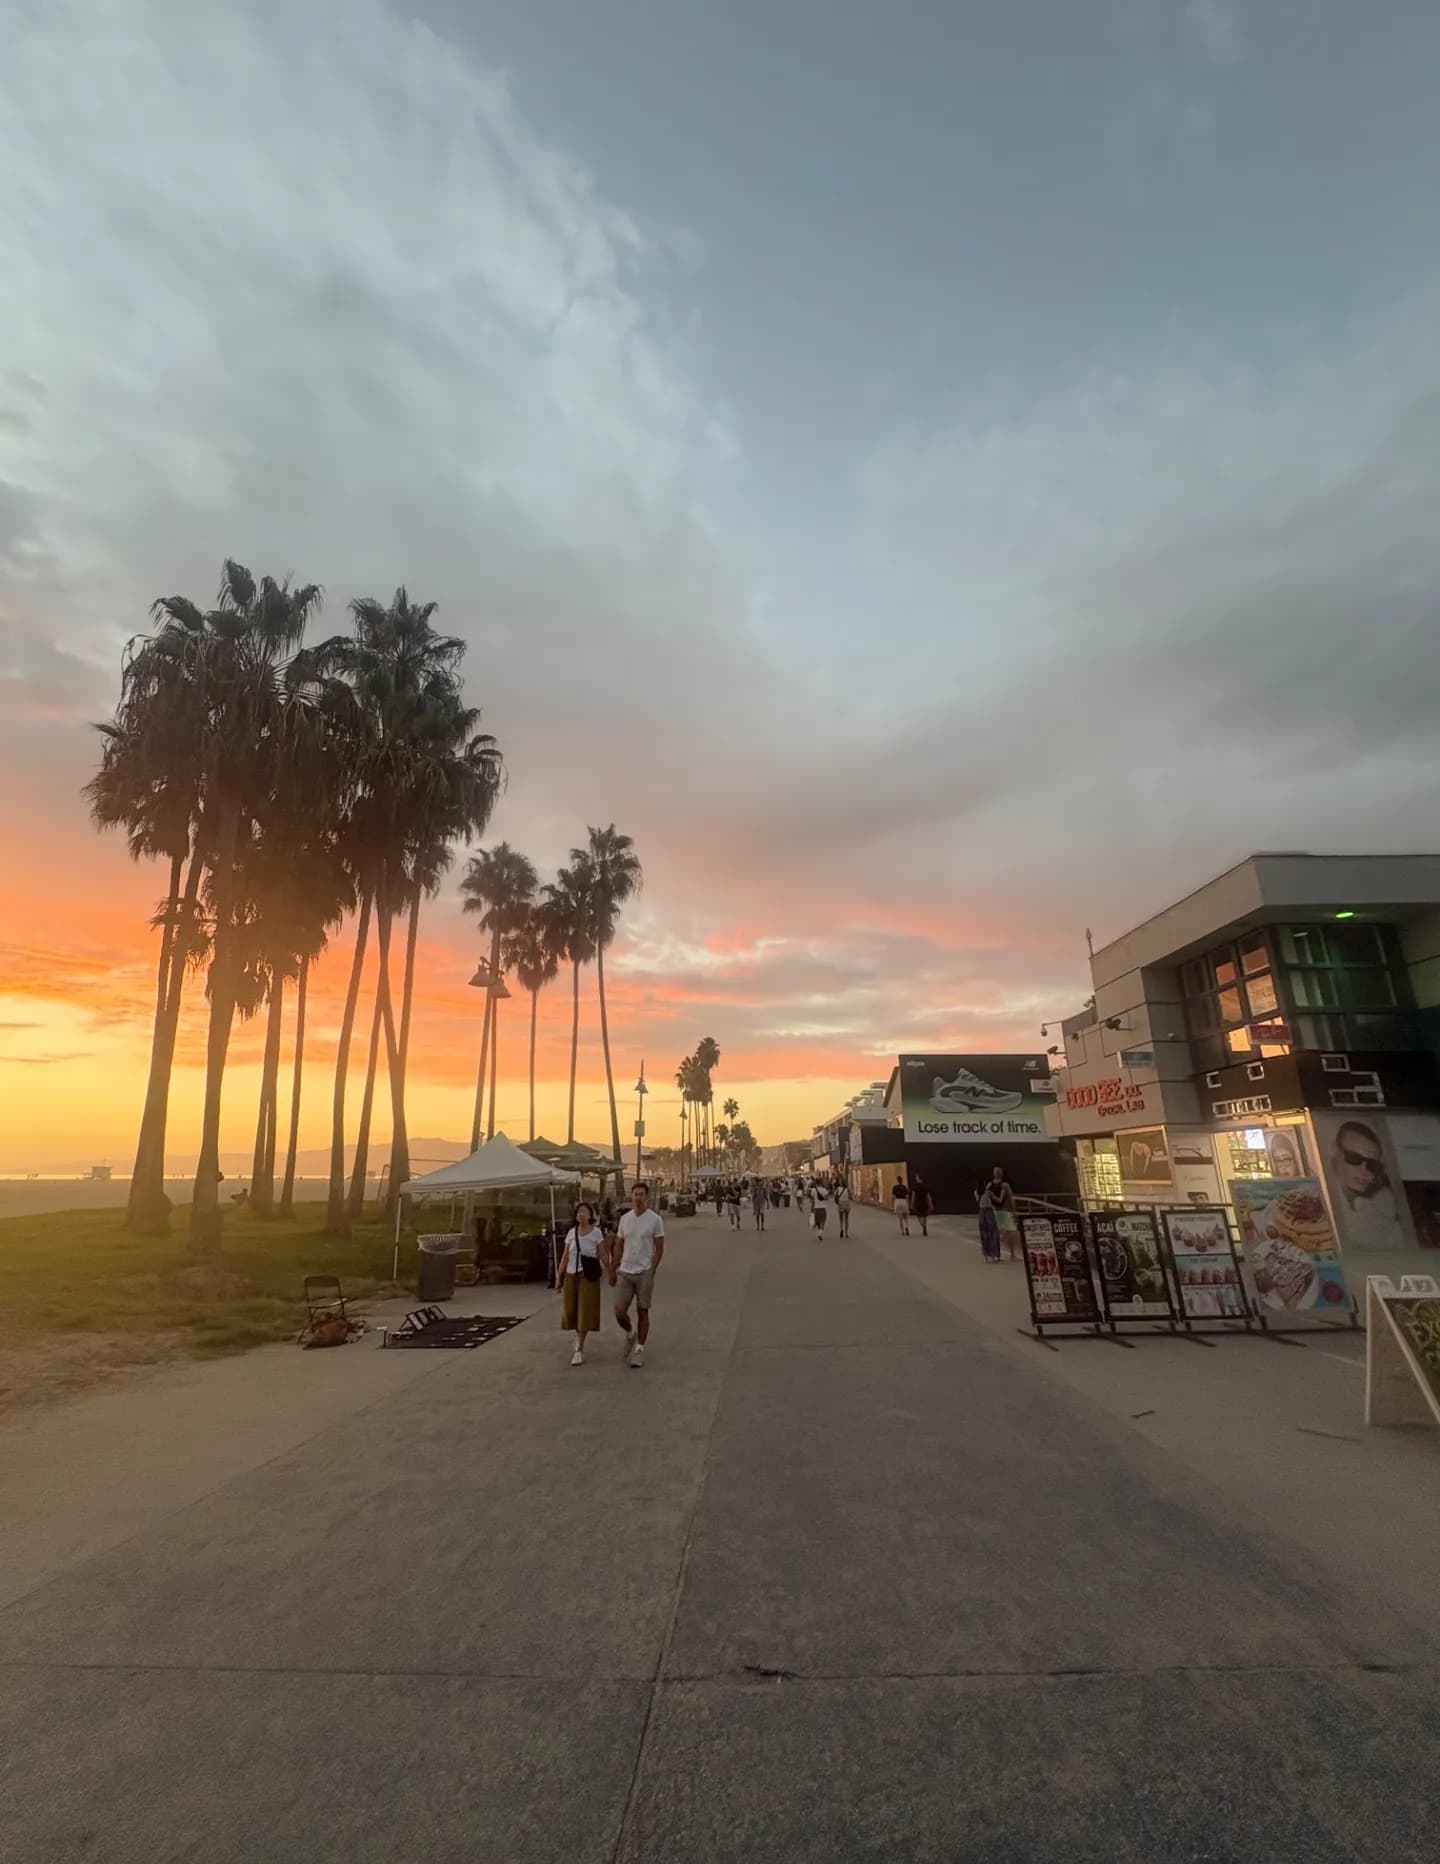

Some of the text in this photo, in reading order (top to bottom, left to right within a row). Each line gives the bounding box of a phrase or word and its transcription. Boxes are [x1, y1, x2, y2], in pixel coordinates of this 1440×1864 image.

[918, 1120, 1042, 1134] Lose track of time.
[1053, 1222, 1079, 1233] COFFEE
